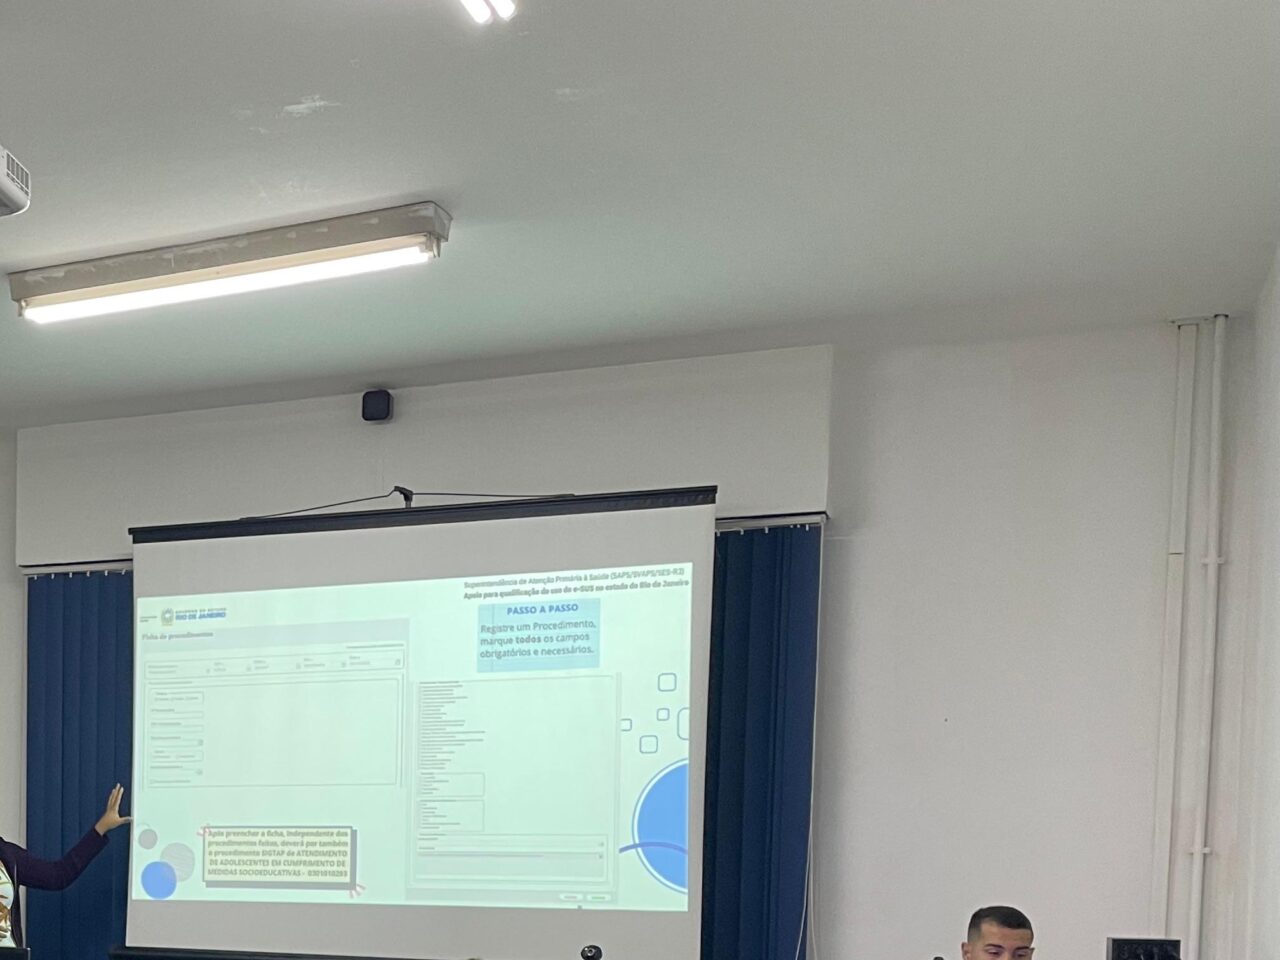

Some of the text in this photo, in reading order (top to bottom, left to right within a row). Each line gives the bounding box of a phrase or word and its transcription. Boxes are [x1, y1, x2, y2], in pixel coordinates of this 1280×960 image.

[464, 592, 482, 600] Apoio
[483, 591, 498, 600] para
[507, 606, 537, 615] PASSO
[548, 604, 578, 612] PASSO
[480, 624, 514, 635] Registre
[533, 620, 596, 631] Procedimento,
[480, 636, 513, 647] marque
[516, 634, 542, 644] todos
[556, 632, 590, 642] campos
[480, 645, 594, 660] obrigatórios e necessários.
